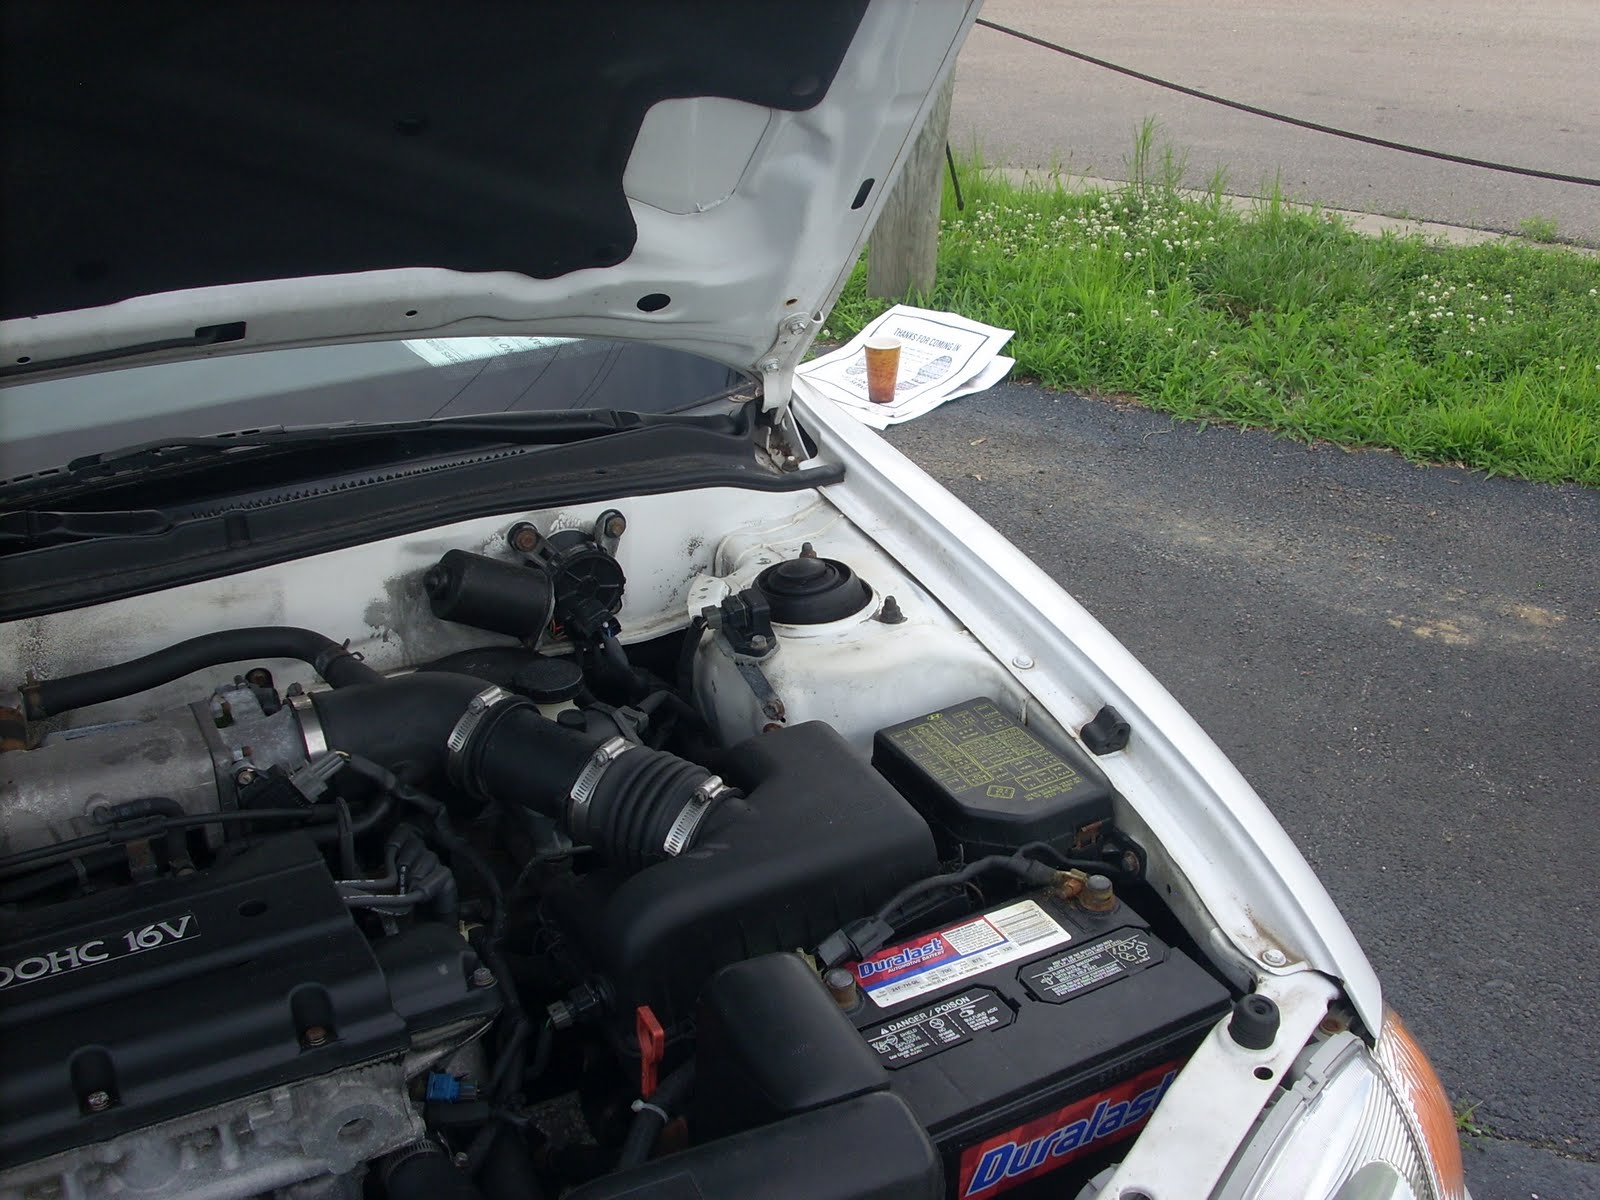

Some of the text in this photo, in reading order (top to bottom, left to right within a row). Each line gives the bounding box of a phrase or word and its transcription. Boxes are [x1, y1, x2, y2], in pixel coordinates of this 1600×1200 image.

[893, 328, 962, 352] THANKS FOR COMING IN
[123, 915, 192, 952] 16V
[858, 938, 943, 978] Duralast
[887, 950, 945, 973] AUTOMOTIVE BATTERY
[888, 1012, 928, 1031] DANGER
[935, 996, 971, 1014] POISON
